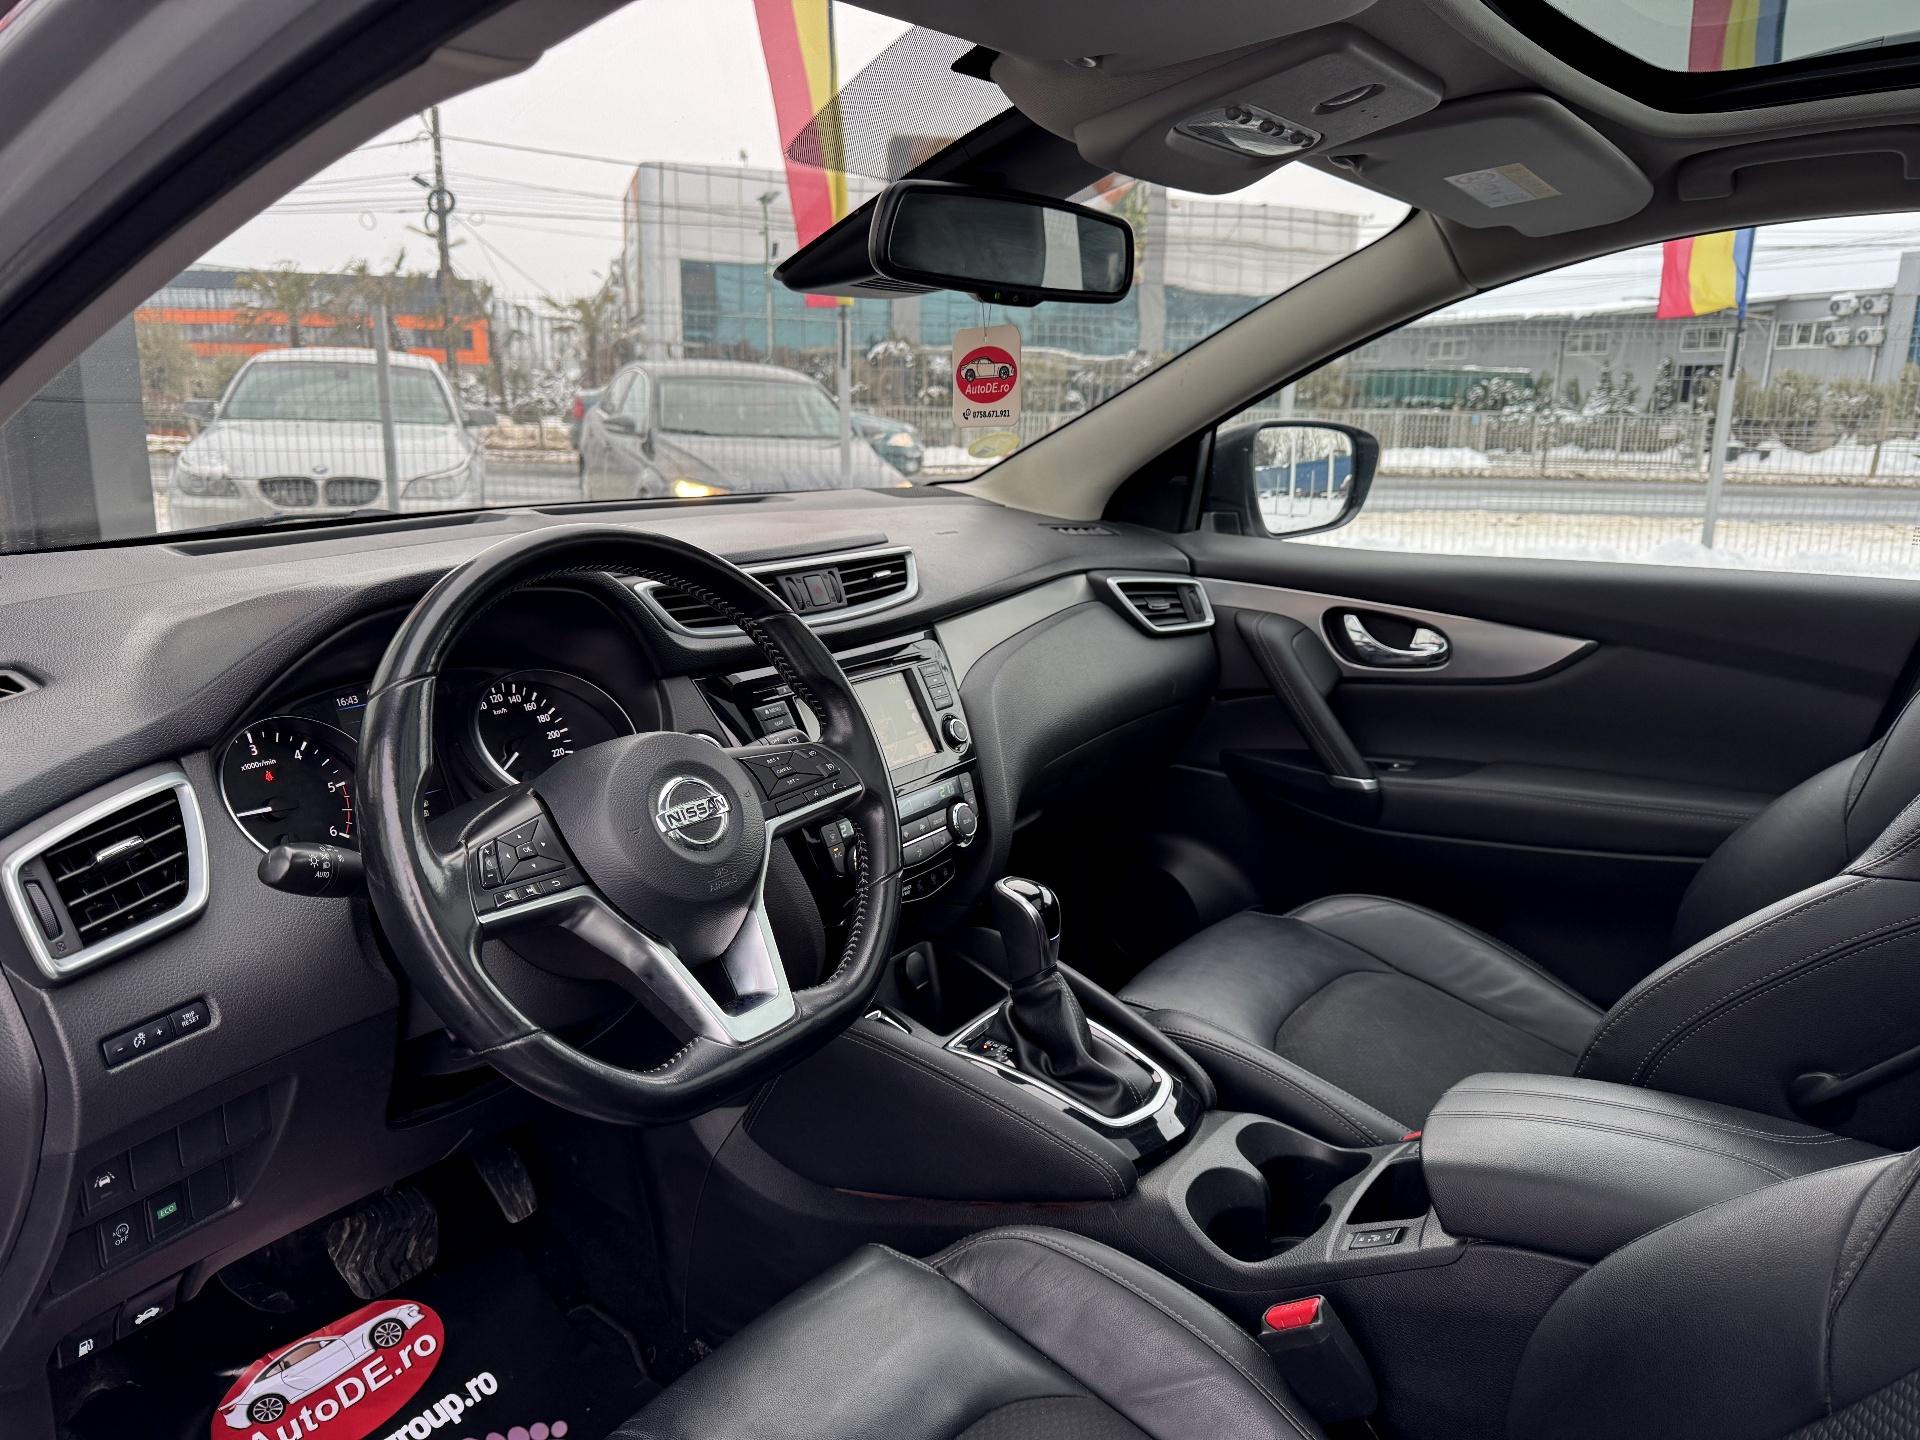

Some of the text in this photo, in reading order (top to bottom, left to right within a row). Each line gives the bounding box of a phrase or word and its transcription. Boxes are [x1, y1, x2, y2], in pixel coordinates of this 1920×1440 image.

[965, 382, 1010, 395] AutoDE.ro
[972, 409, 1010, 419] 0758.671.921
[336, 695, 359, 707] 16:43
[489, 693, 504, 704] 120
[507, 694, 522, 704] 140
[492, 707, 508, 716] km/h
[523, 701, 537, 712] 160
[536, 713, 551, 723] 180
[546, 730, 561, 740] 200
[248, 744, 258, 756] 3
[294, 749, 303, 760] 4
[551, 747, 565, 758] 220
[327, 781, 336, 793] 5
[666, 796, 727, 827] NISSAN
[329, 825, 338, 837] 6
[181, 1010, 195, 1020] TRIP
[181, 1014, 200, 1028] RESET
[160, 1204, 175, 1217] ECO
[114, 1234, 129, 1246] OFF
